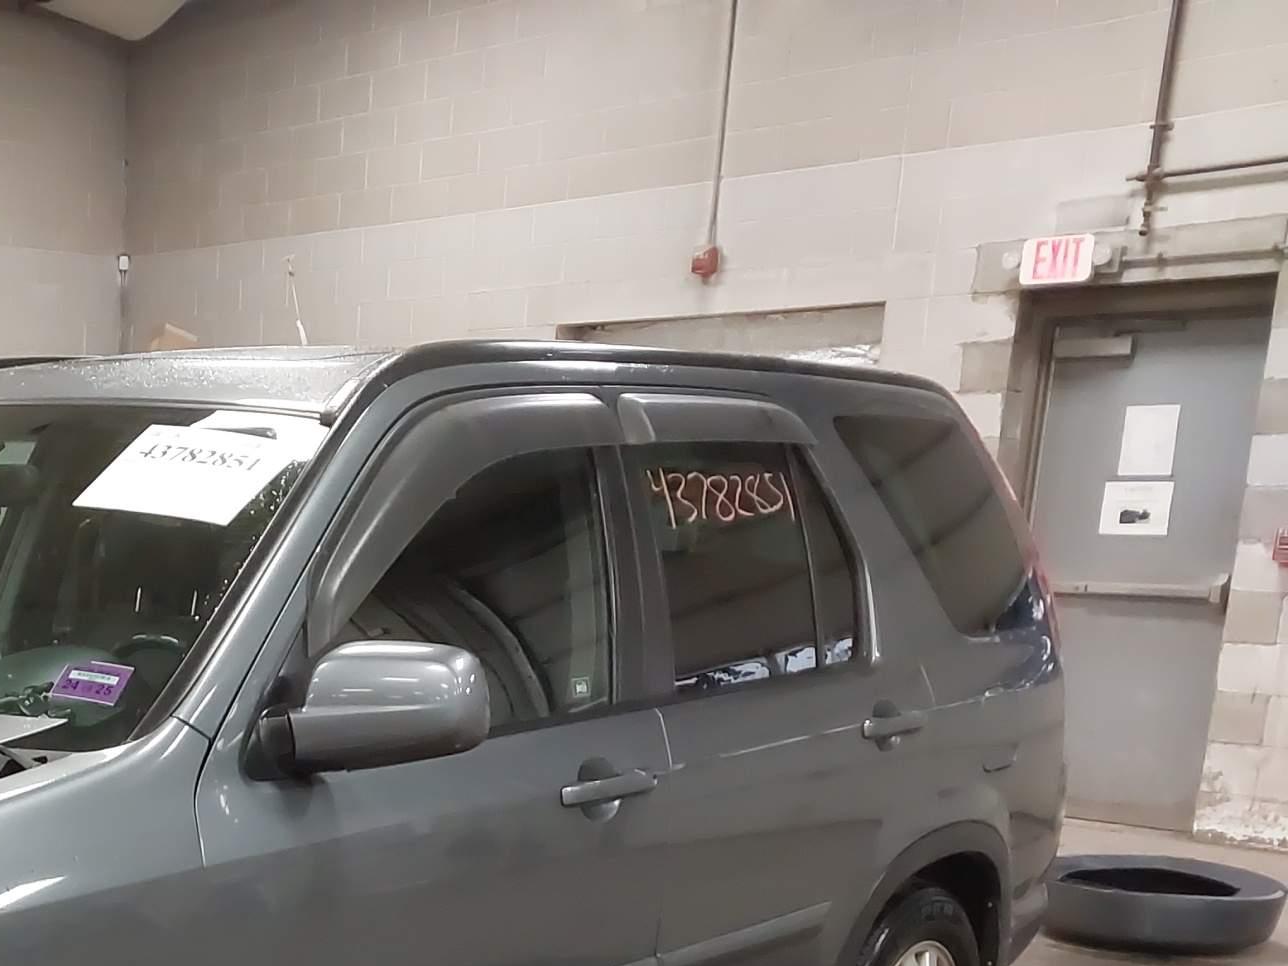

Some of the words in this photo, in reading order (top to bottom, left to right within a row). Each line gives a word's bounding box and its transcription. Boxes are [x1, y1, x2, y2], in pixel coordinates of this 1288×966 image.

[1032, 238, 1085, 280] EXIT
[139, 442, 262, 472] 43782851
[646, 468, 796, 530] 43782851
[61, 679, 80, 691] 24
[95, 684, 114, 696] 25
